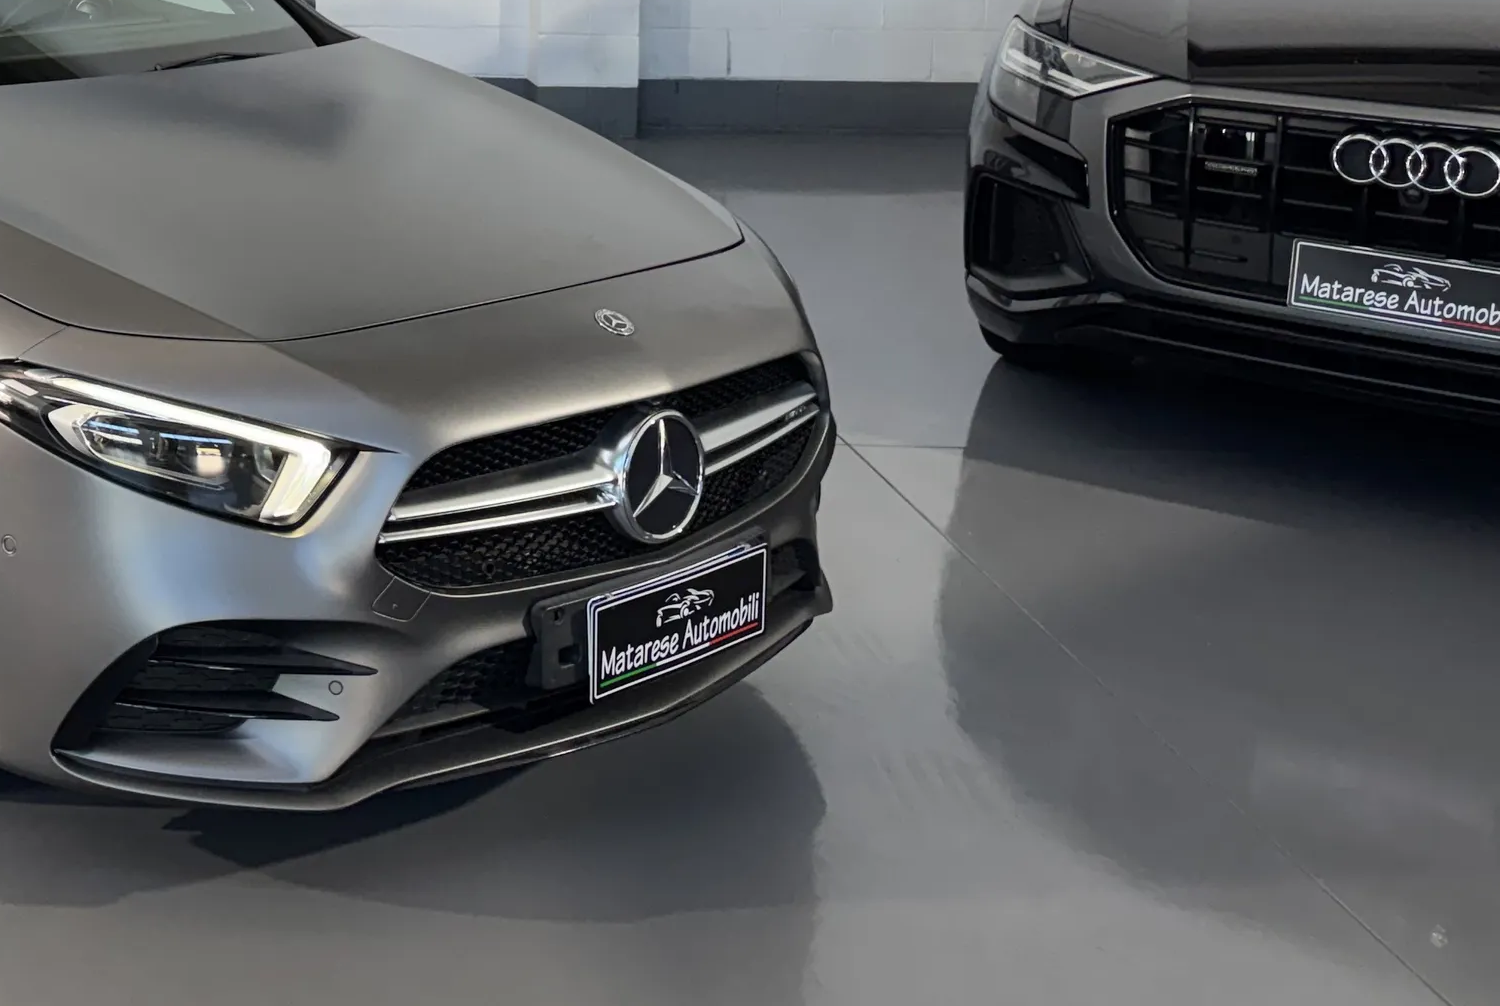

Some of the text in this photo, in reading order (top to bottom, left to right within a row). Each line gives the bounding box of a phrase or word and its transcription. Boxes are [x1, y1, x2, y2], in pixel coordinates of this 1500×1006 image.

[1299, 273, 1400, 310] Matarese
[600, 592, 761, 680] Matarese Automobili
